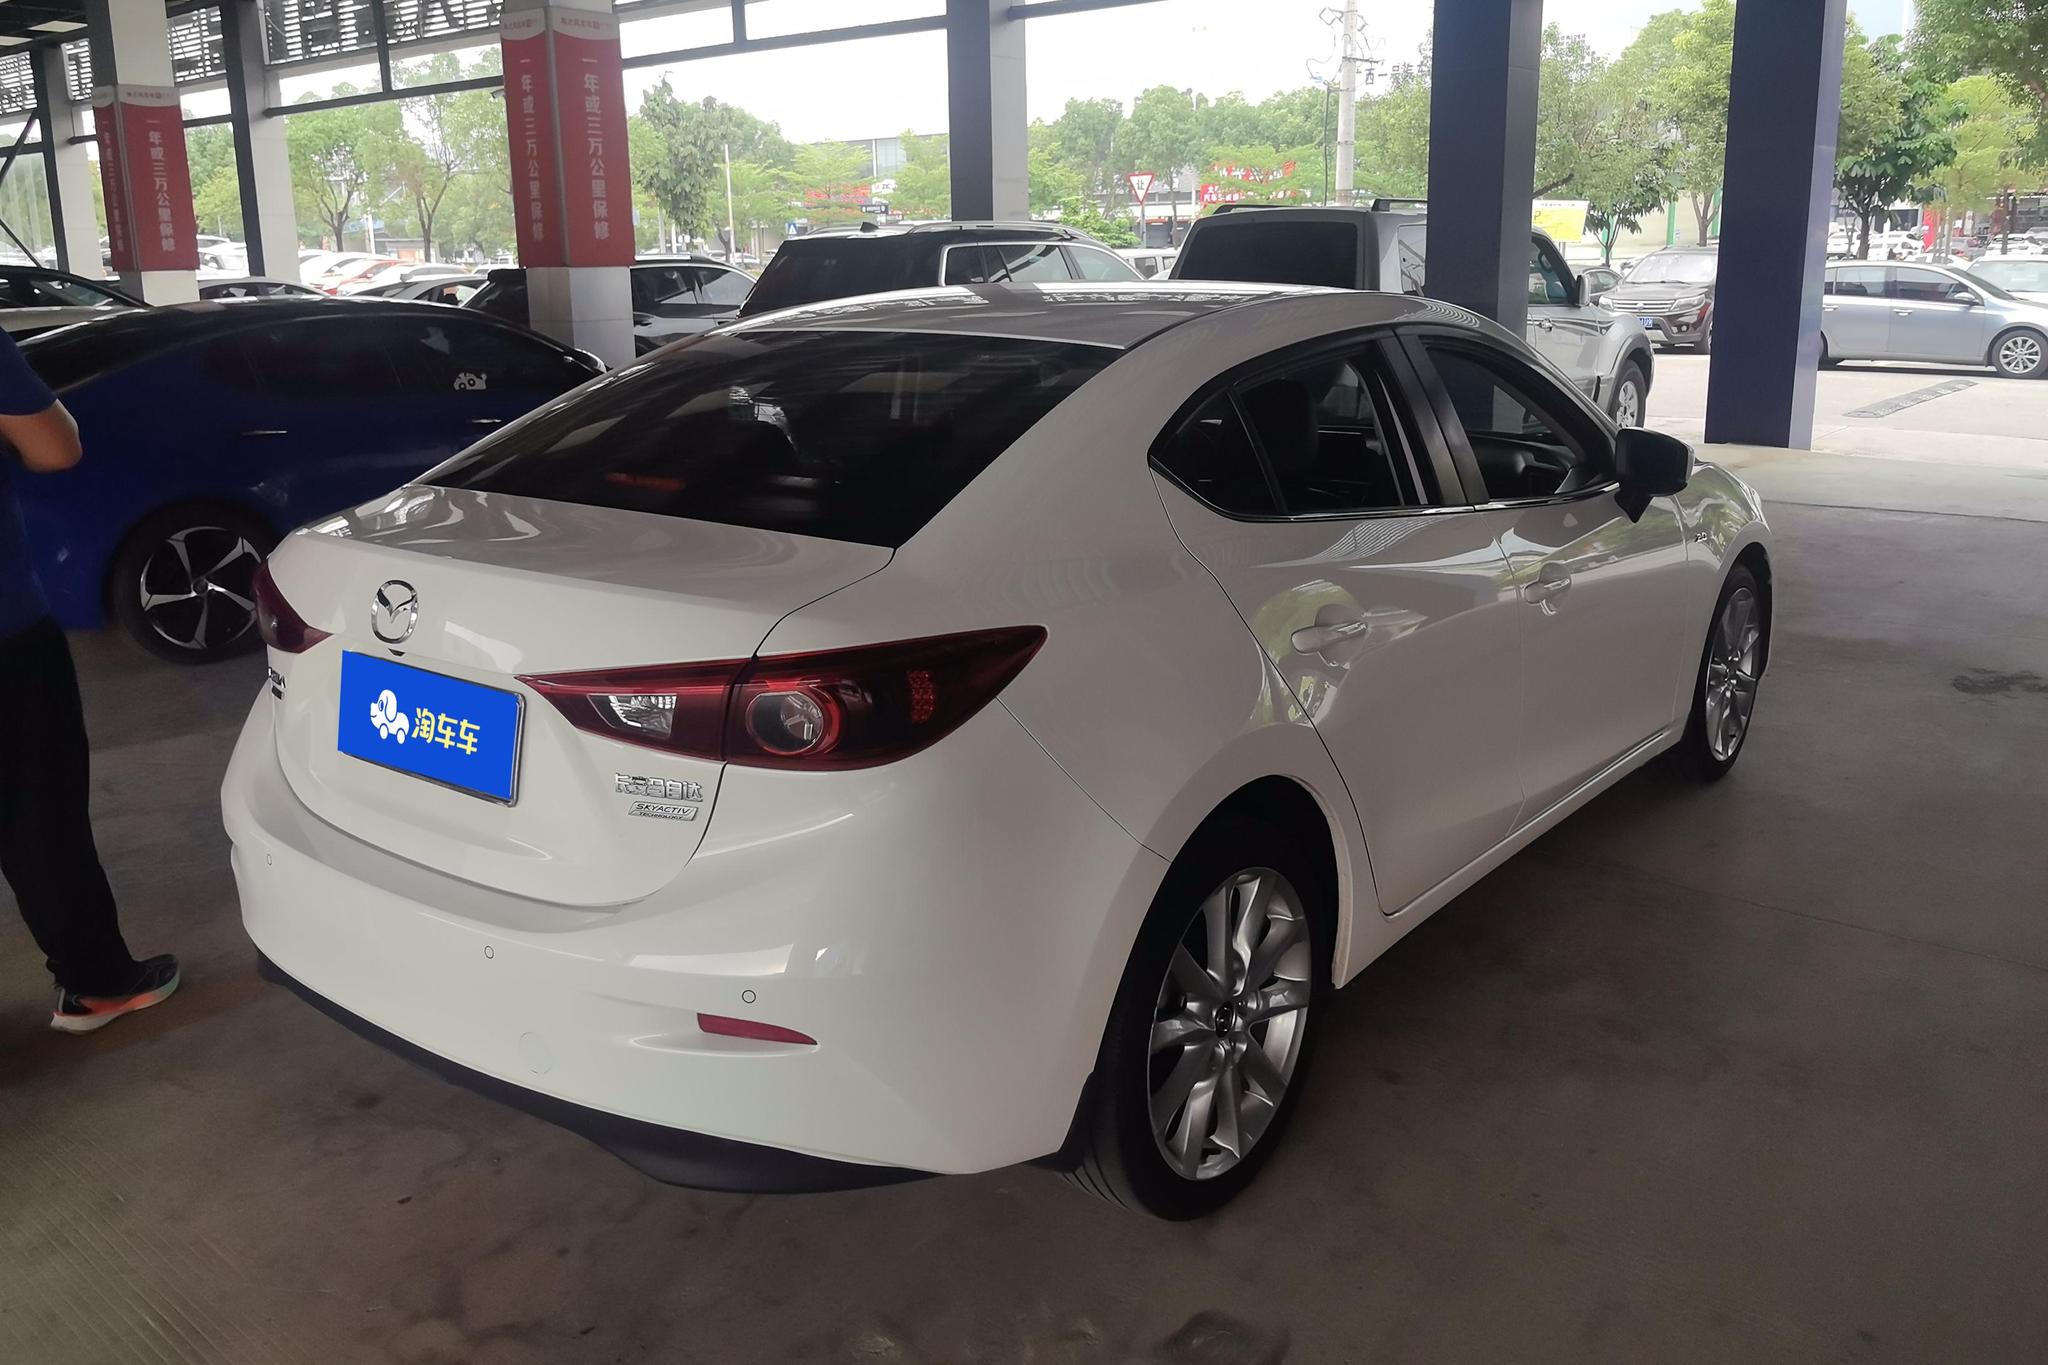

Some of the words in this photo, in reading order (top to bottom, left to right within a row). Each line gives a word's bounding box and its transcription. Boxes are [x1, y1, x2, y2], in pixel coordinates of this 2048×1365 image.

[146, 119, 176, 252] 一年或三万公里保修
[520, 59, 544, 242] 一年或三万公里保修
[582, 58, 610, 240] 一年或三万公里保修
[1137, 178, 1145, 190] 让
[615, 772, 704, 802] 长安马自达
[636, 803, 691, 815] SKYACTIV
